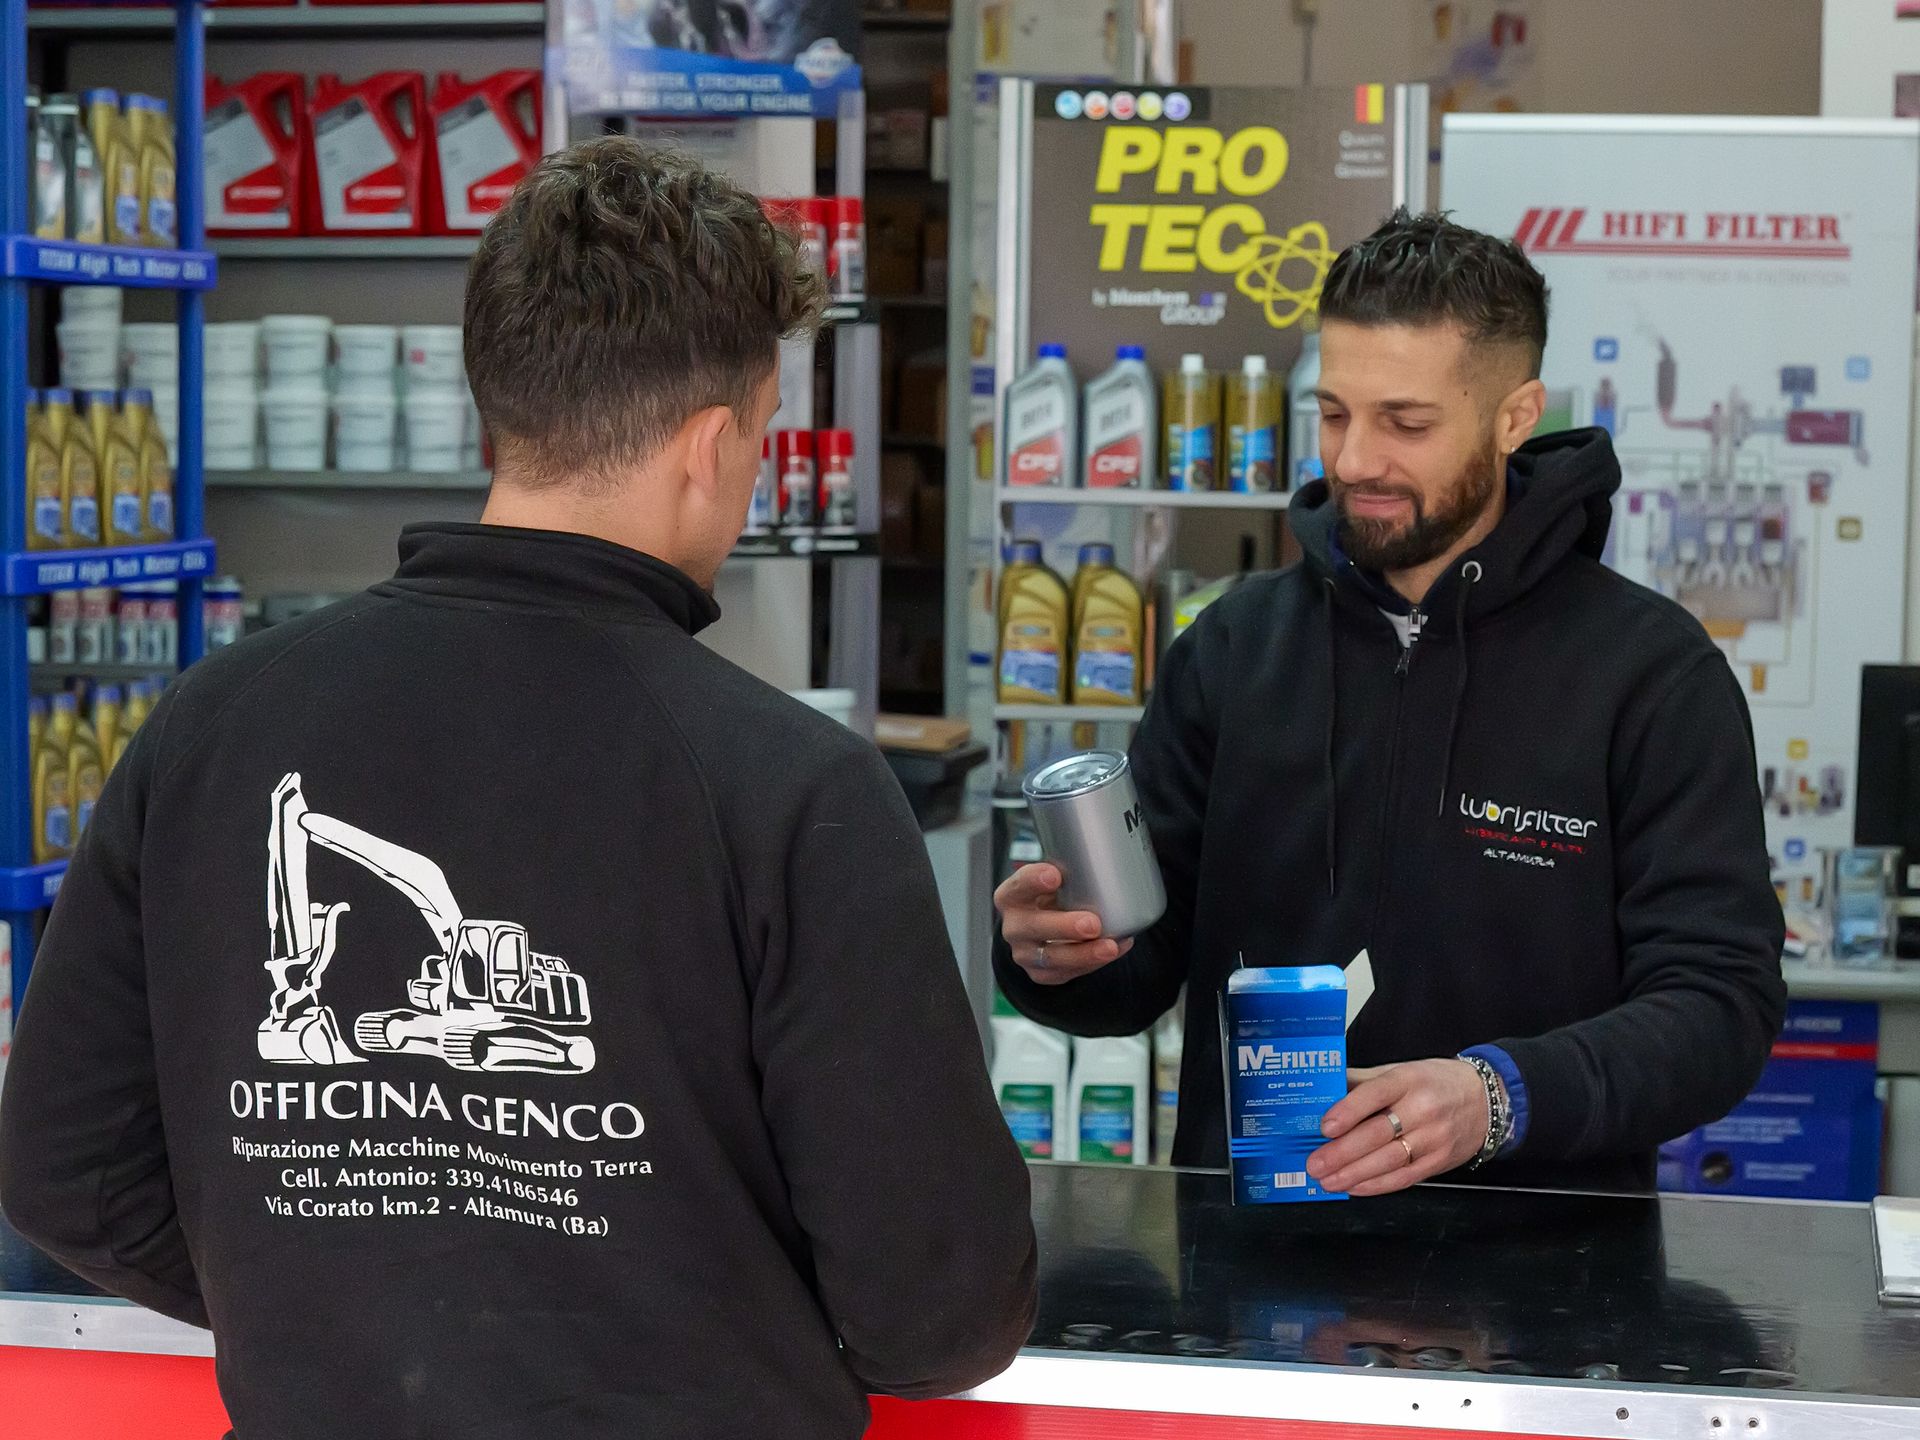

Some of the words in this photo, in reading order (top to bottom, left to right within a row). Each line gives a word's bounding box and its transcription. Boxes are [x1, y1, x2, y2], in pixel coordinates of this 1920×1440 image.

[1095, 126, 1290, 195] PRO
[1089, 204, 1266, 274] TEC
[1602, 212, 1686, 238] HIFI
[1705, 214, 1840, 240] FILTER
[79, 252, 109, 279] High
[1483, 847, 1556, 868] ALTAMURA
[1239, 1069, 1300, 1077] AUTOMOTIVE
[1303, 1067, 1342, 1075] FILTERS
[230, 1080, 452, 1120] OFFICINA
[461, 1094, 645, 1142] GENCO
[232, 1136, 340, 1161] Riparazione
[348, 1136, 461, 1158] Macchine
[467, 1143, 583, 1179] Movimento
[590, 1159, 653, 1178] Terra
[281, 1168, 328, 1188] Cell.
[335, 1166, 437, 1187] Antonio:
[446, 1168, 579, 1207] 339.4186546
[264, 1195, 294, 1216] Via
[297, 1198, 374, 1217] Corato
[382, 1195, 440, 1216] km.2
[463, 1196, 557, 1230] Altamura
[562, 1216, 609, 1237] (Ba)
